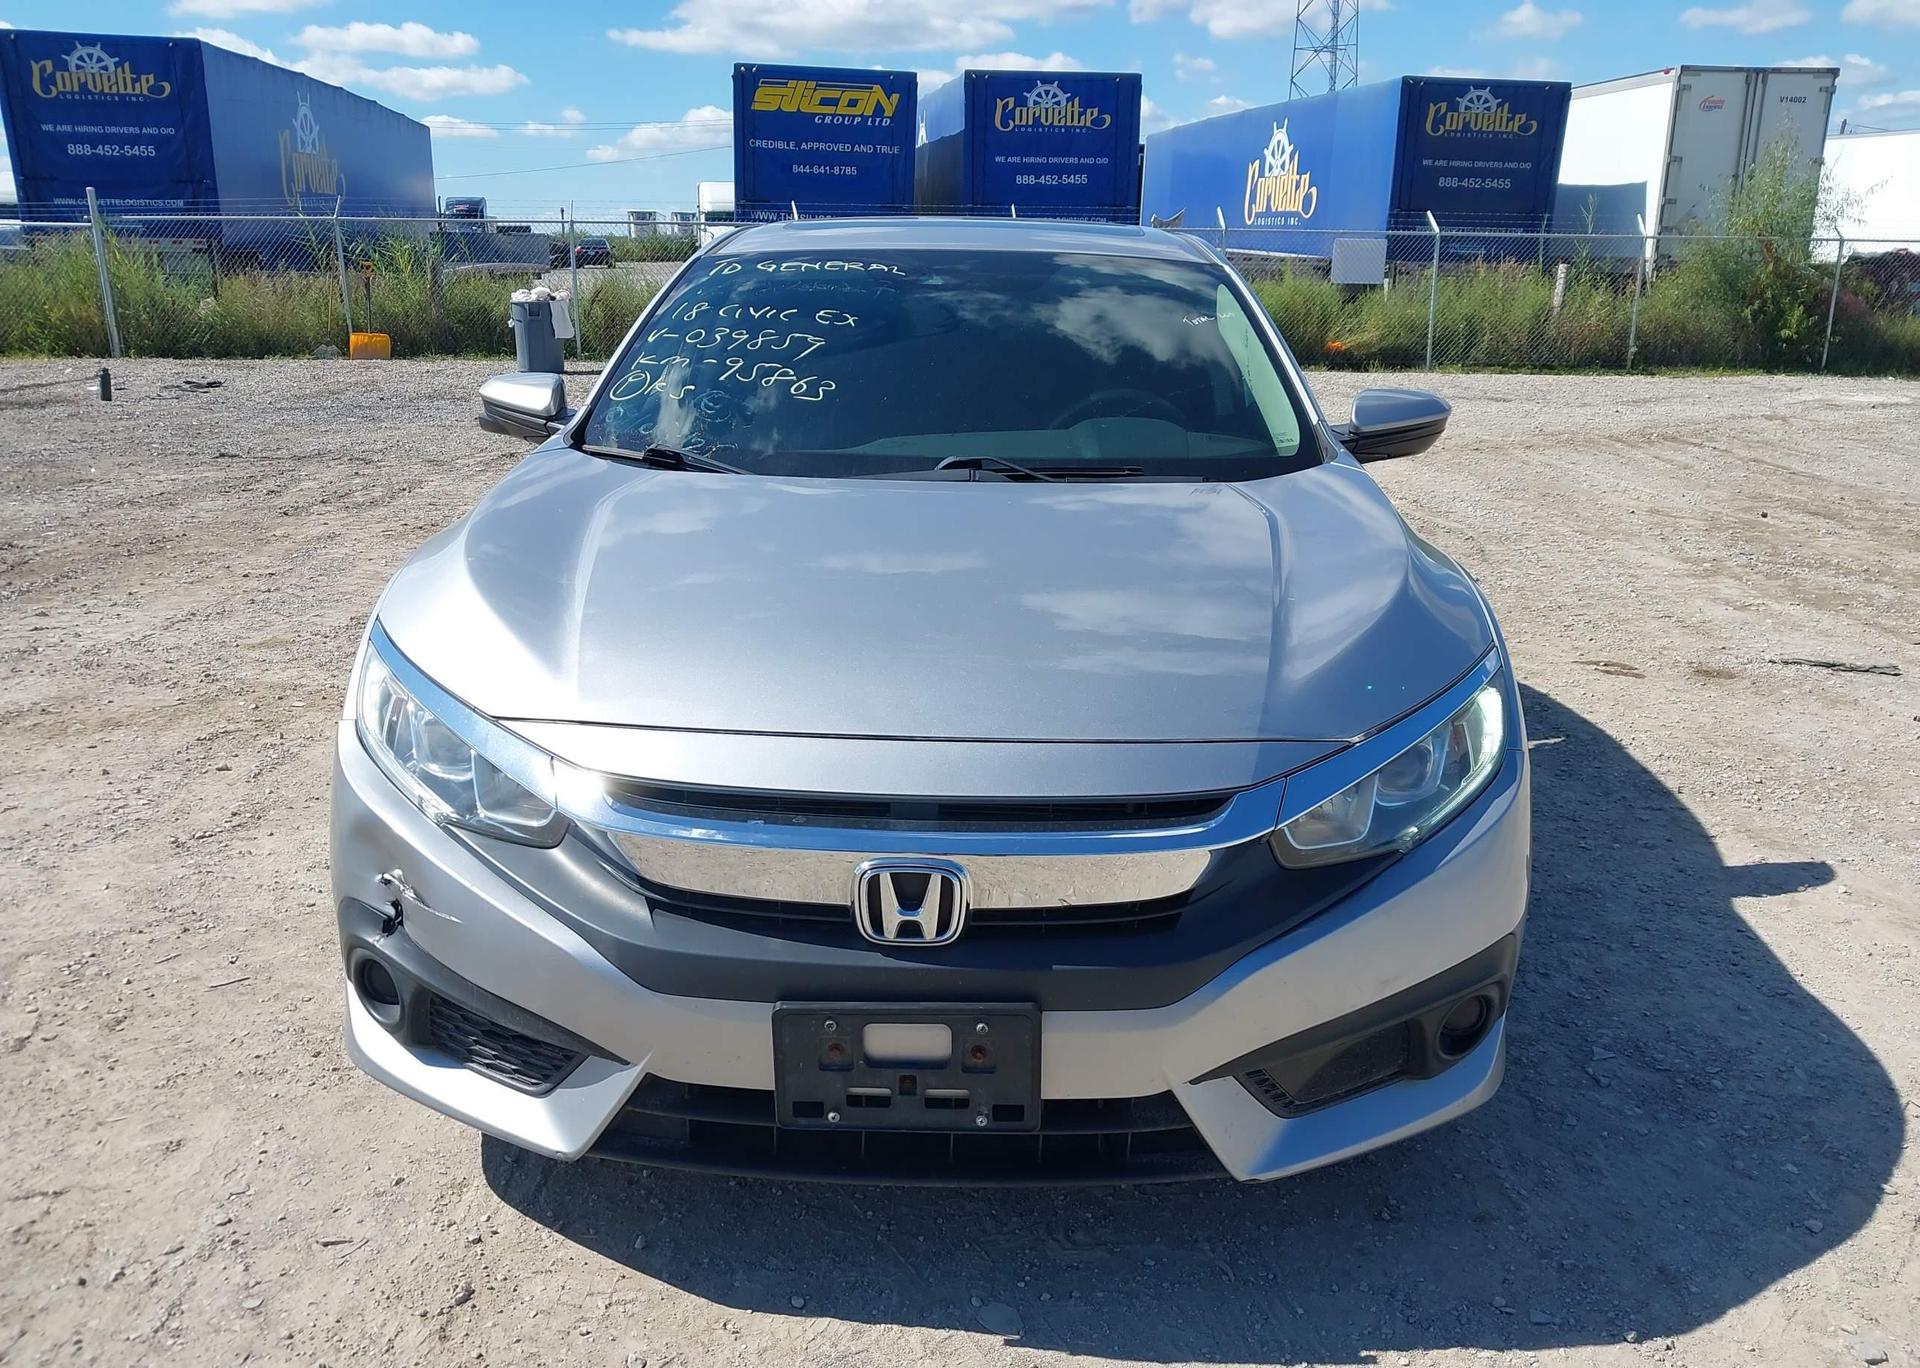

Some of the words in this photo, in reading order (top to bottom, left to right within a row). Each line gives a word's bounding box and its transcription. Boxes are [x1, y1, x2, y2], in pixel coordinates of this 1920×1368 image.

[30, 59, 171, 98] Corvette
[58, 94, 119, 102] LOGISTICS
[1779, 95, 1808, 104] V14002
[994, 96, 1112, 132] Corvette
[1425, 101, 1538, 136] Corvette
[814, 115, 862, 126] GROUP
[40, 123, 55, 132] WE
[56, 124, 73, 133] ARE
[74, 125, 104, 134] HIRING
[105, 126, 140, 135] DRIVERS
[141, 127, 159, 135] AND
[67, 143, 156, 157] 888-452-5455
[749, 138, 799, 151] CREDIBLE,
[800, 141, 852, 152] APPROVED
[853, 144, 874, 153] AND
[875, 145, 900, 154] TRUE
[1022, 156, 1048, 164] HIRING
[1422, 158, 1434, 166] WE
[1434, 159, 1448, 167] ARE
[1449, 160, 1473, 168] HIRING
[1474, 160, 1503, 169] DRIVERS
[1503, 161, 1519, 169] AND
[792, 164, 857, 176] 844-641-8785
[1015, 174, 1088, 185] 888-452-5455
[1438, 176, 1512, 189] 888-452-5455
[1244, 150, 1318, 225] Corvette
[1254, 216, 1285, 226] LOGISTICS
[756, 260, 907, 277] GENERAL
[671, 302, 710, 321] 18
[718, 303, 798, 322] CIVIC
